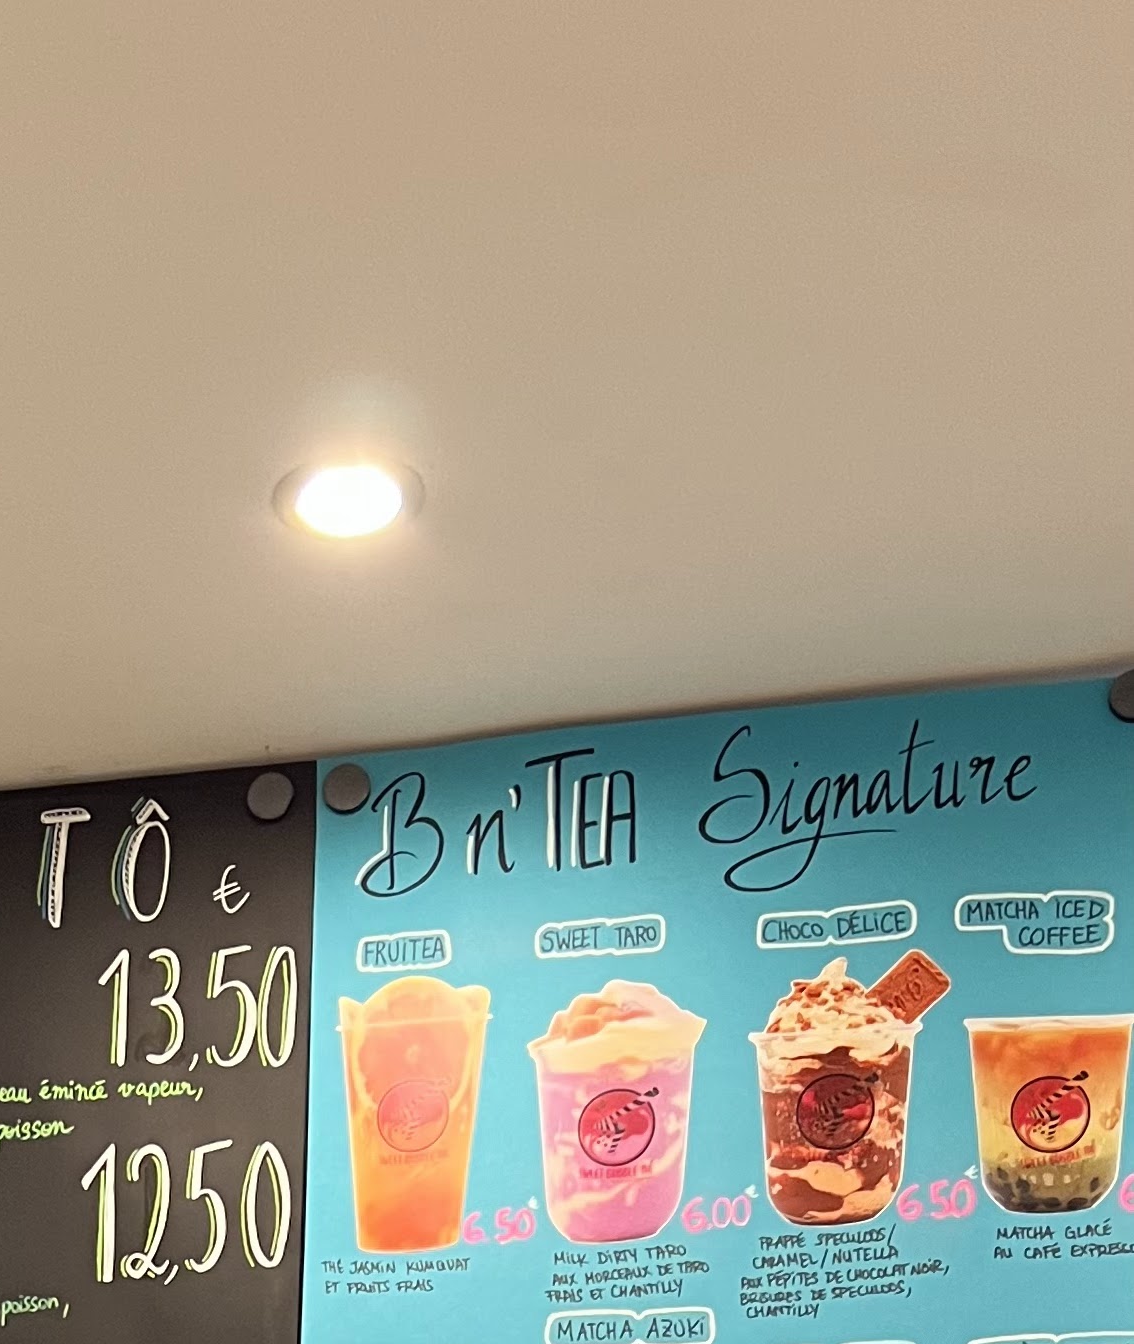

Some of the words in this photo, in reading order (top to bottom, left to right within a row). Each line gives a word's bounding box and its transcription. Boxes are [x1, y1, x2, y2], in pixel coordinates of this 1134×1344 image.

[697, 719, 1037, 893] Signature
[967, 901, 1040, 922] MATCHA
[541, 927, 600, 952] SWEET
[613, 926, 656, 947] TARO
[763, 918, 824, 943] CHOCO
[1018, 923, 1101, 946] COFFEE
[99, 945, 298, 1072] 13,50
[118, 1079, 203, 1108] vapeur,
[80, 1139, 291, 1284] 12,50
[996, 1225, 1055, 1240] MATCHA
[1065, 1220, 1113, 1239] GLACÉ
[1024, 1243, 1061, 1259] CAFÉ
[325, 1280, 341, 1294] ET
[0, 1291, 70, 1326] poisson,
[557, 1320, 633, 1341] MATCHA
